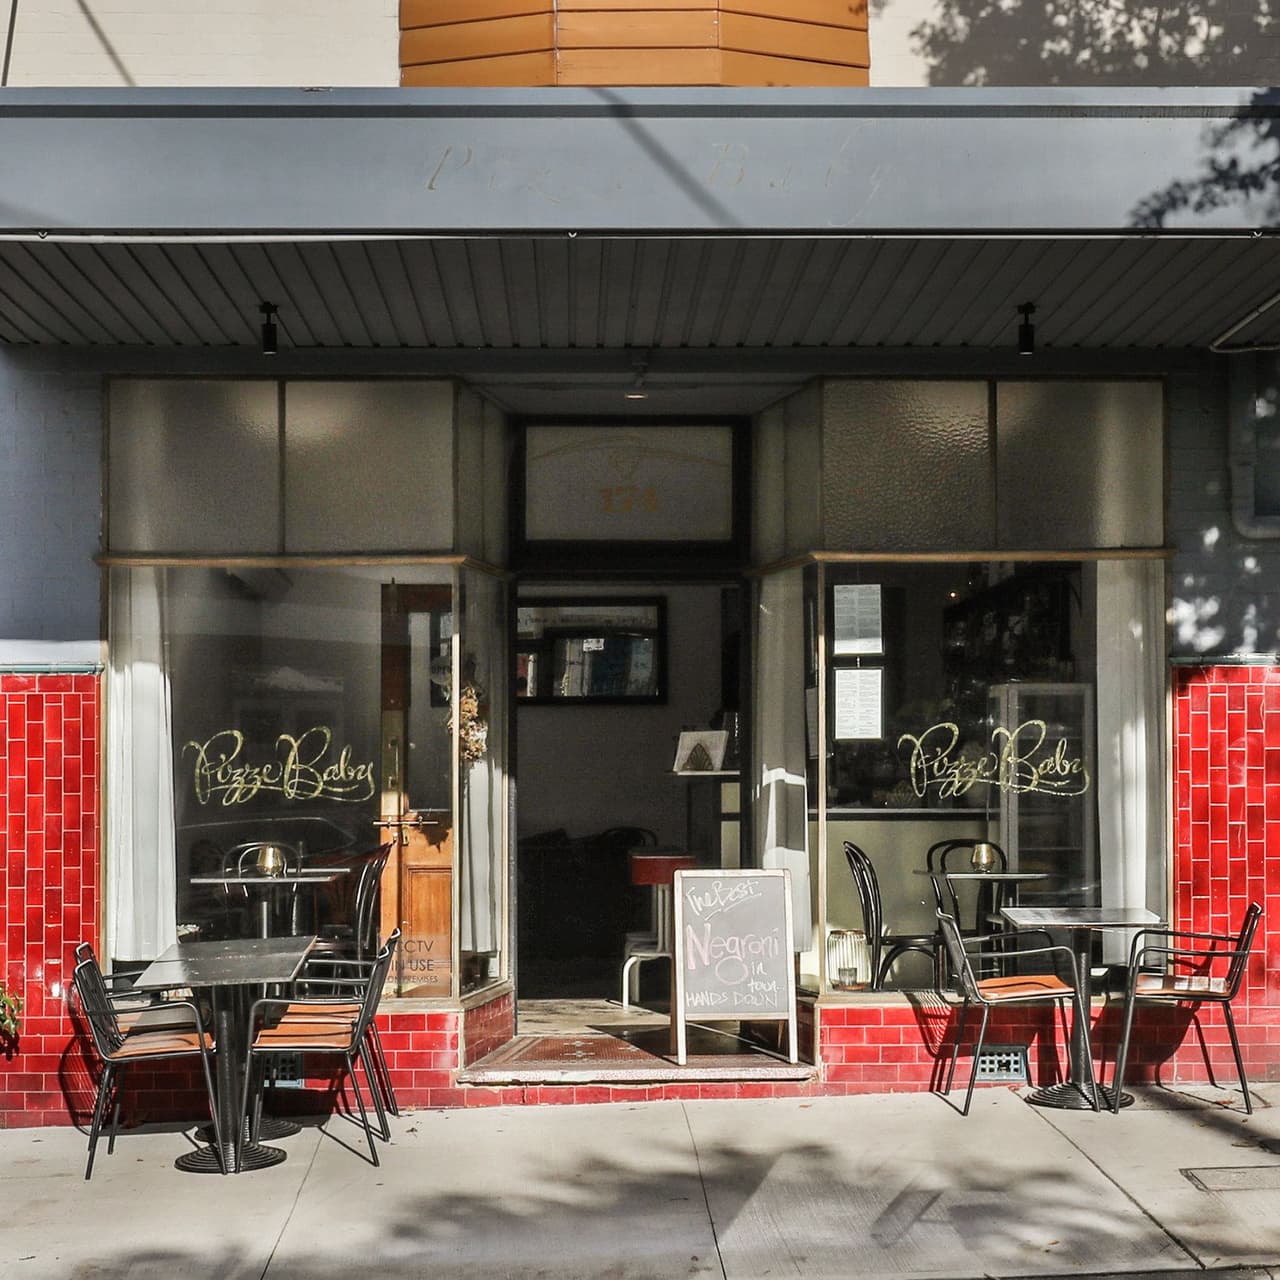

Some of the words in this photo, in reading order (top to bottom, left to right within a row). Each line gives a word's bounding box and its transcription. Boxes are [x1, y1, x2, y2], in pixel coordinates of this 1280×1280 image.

[182, 729, 283, 806] Pizze
[275, 726, 375, 802] Baby
[898, 722, 998, 799] Pizze
[410, 960, 435, 972] USE
[686, 990, 728, 1007] HANDS
